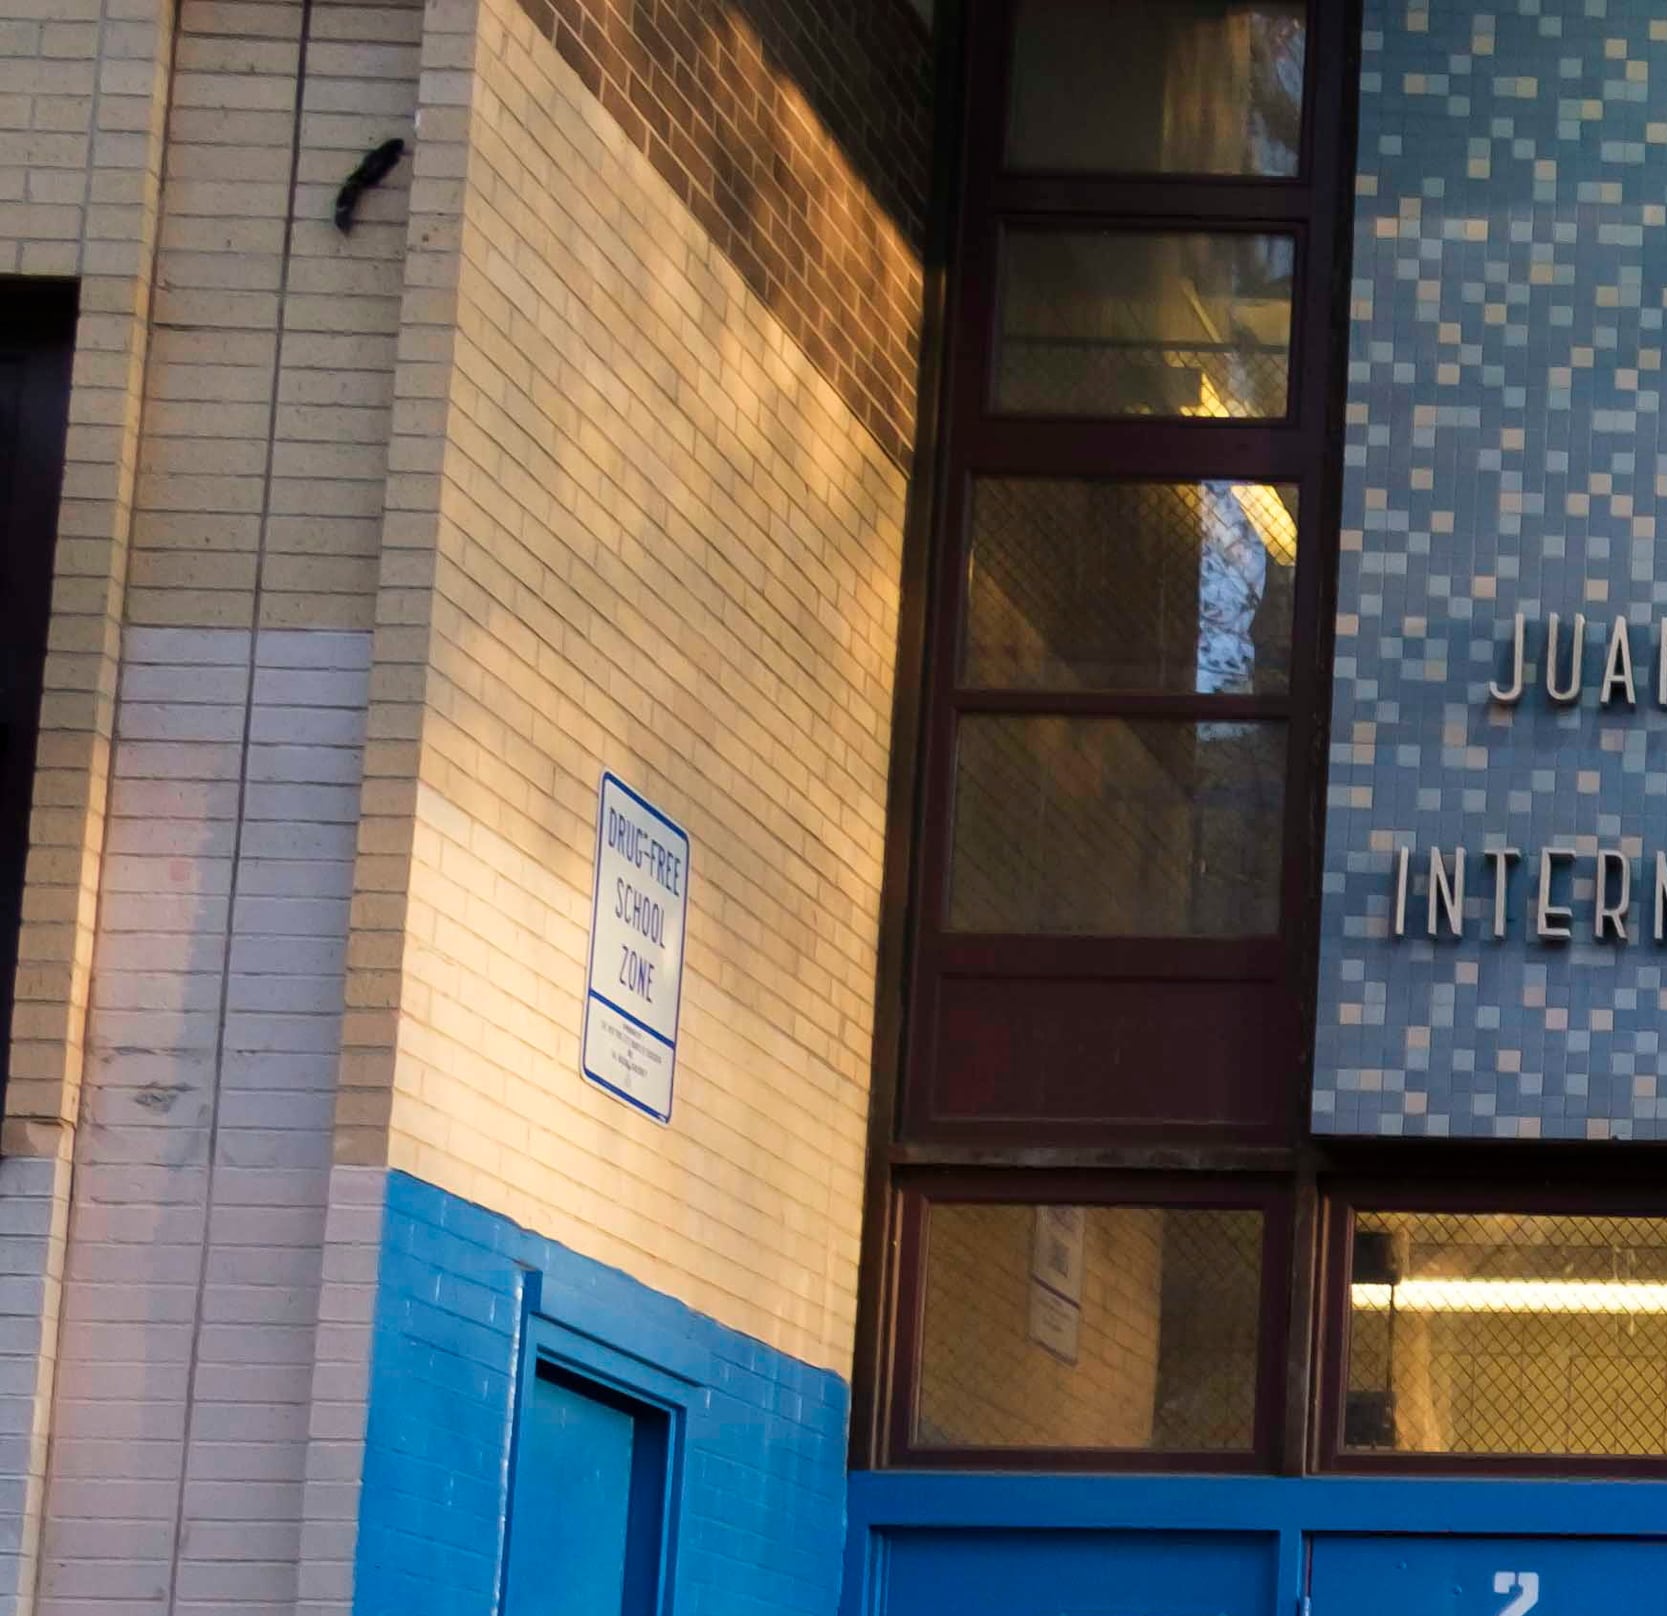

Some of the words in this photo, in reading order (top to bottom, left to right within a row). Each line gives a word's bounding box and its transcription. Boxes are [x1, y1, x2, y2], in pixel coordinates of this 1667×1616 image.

[607, 805, 681, 898] DRUG-FREE
[615, 876, 667, 950] SCHOOL
[619, 943, 656, 1004] ZONE
